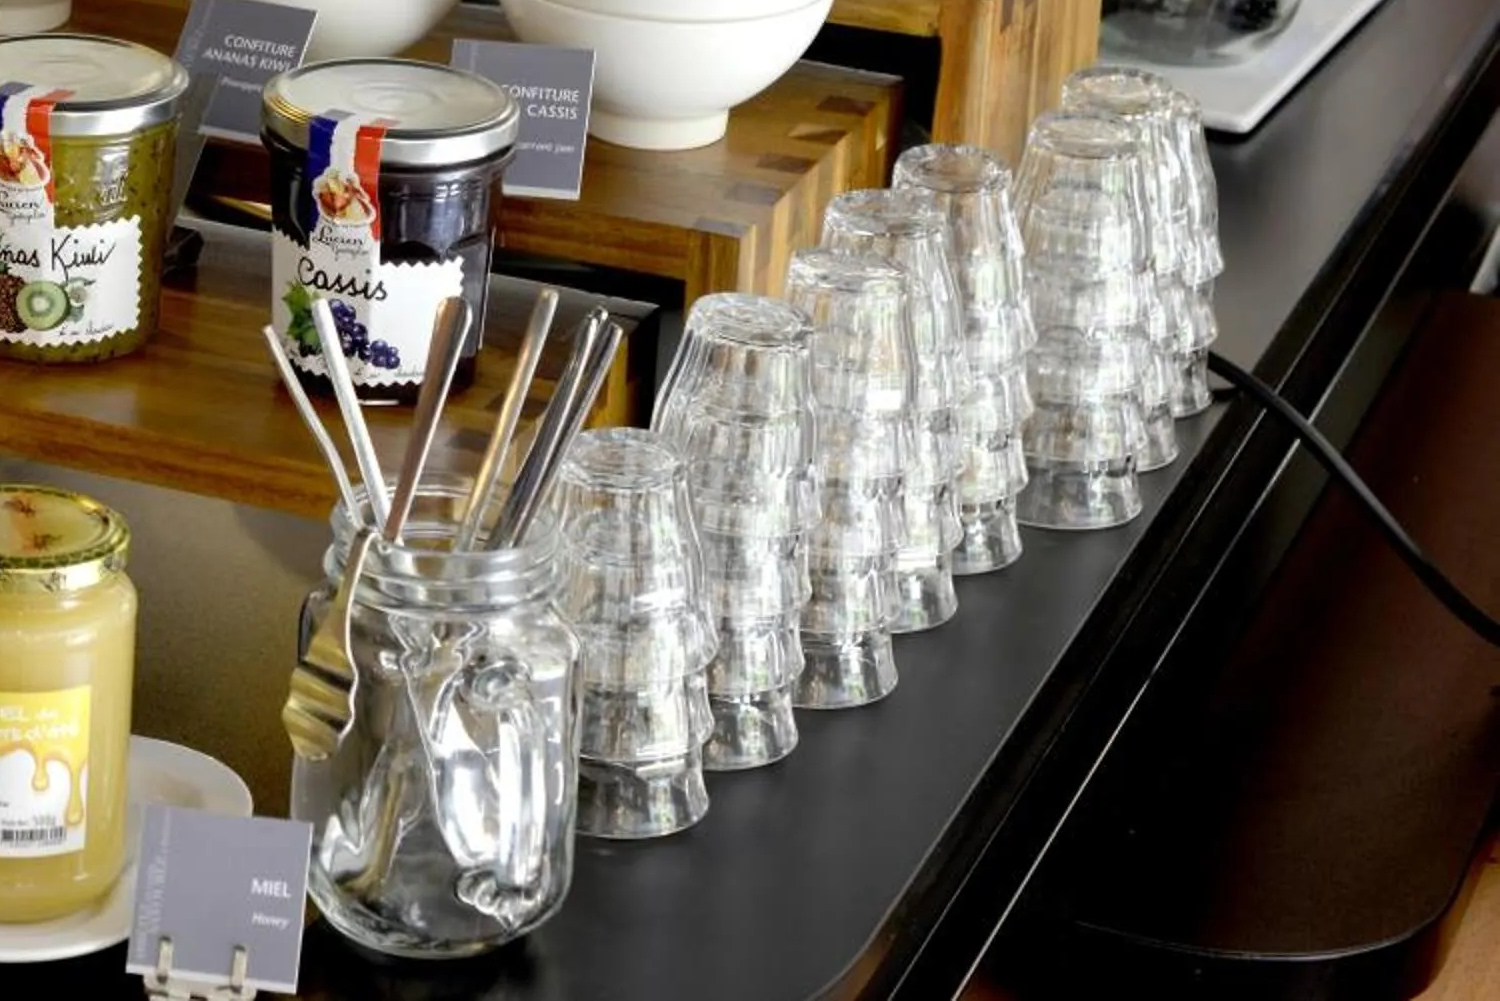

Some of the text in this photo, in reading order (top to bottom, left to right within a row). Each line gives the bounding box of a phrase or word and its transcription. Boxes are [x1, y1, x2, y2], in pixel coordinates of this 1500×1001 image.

[224, 35, 296, 57] CONFITURE
[202, 47, 256, 68] ANANAS
[527, 104, 578, 120] CASSIS
[51, 234, 116, 281] Kiwi
[297, 256, 388, 301] Cassis
[251, 877, 292, 898] MIEL
[252, 911, 290, 930] Honey
